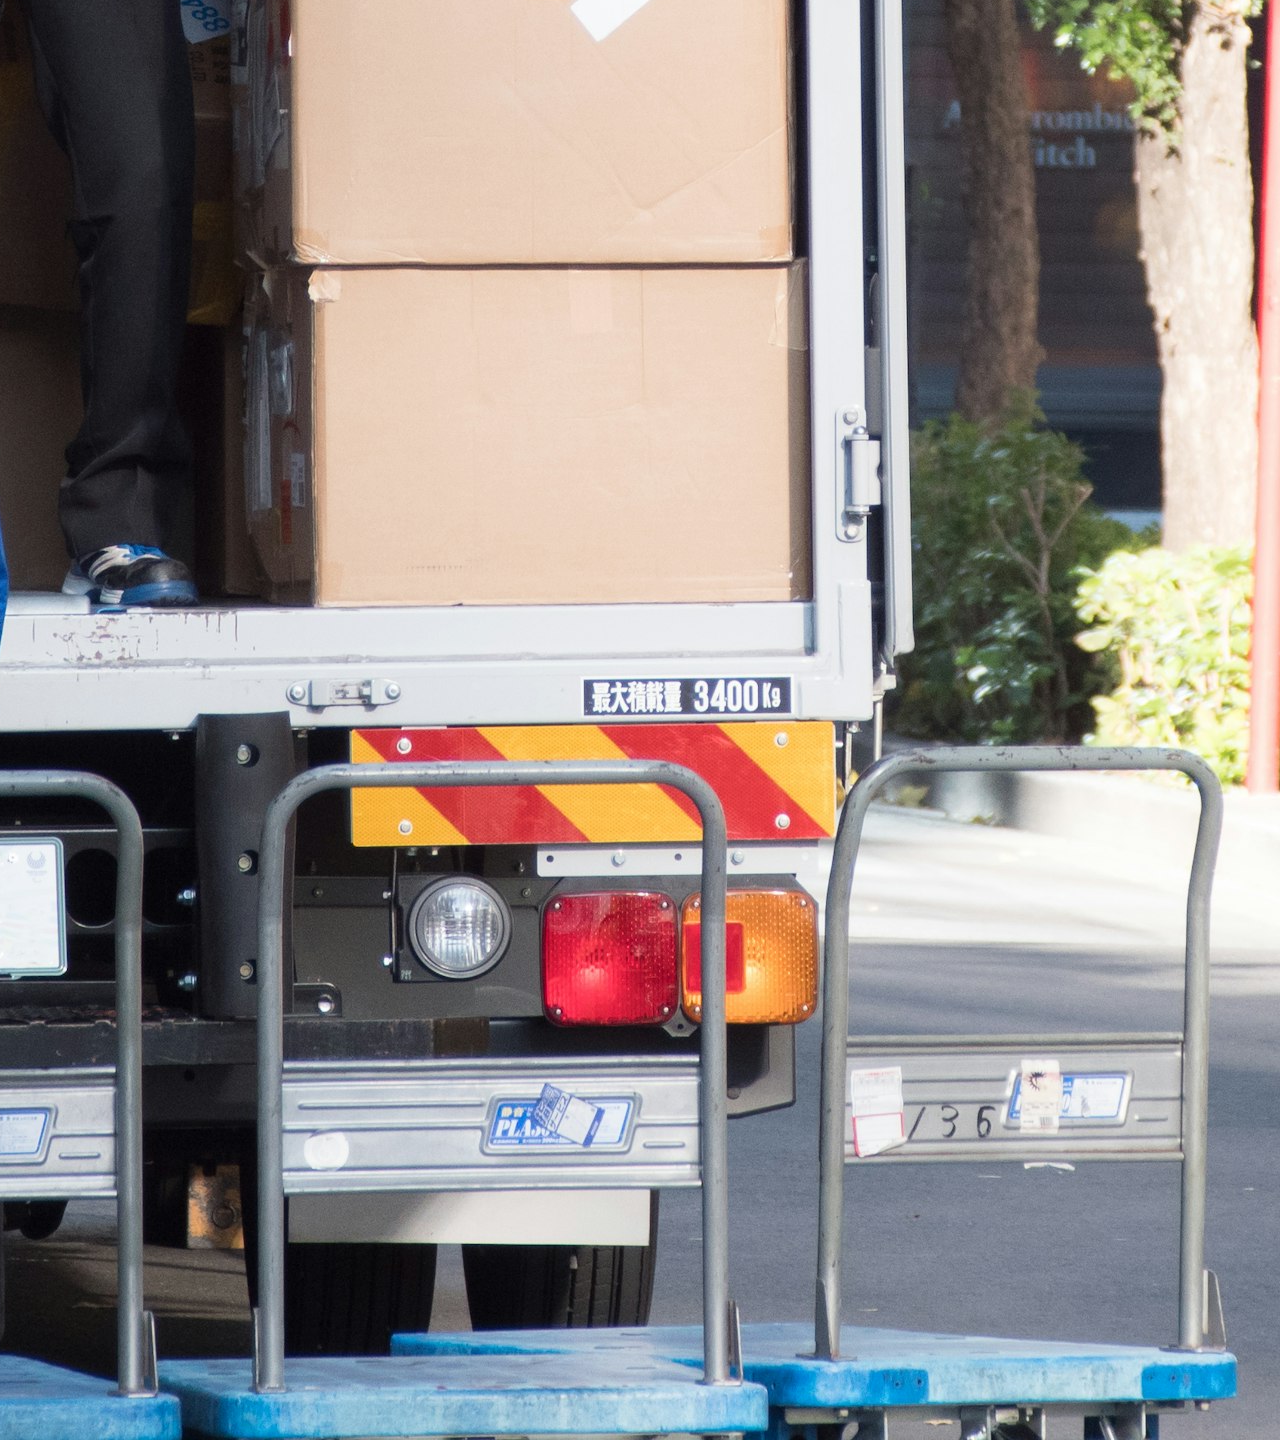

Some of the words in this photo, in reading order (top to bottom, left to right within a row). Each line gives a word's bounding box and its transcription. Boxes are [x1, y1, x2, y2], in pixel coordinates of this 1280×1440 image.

[1032, 134, 1097, 168] itch
[591, 680, 683, 714] 最大積載量
[694, 679, 759, 714] 3400
